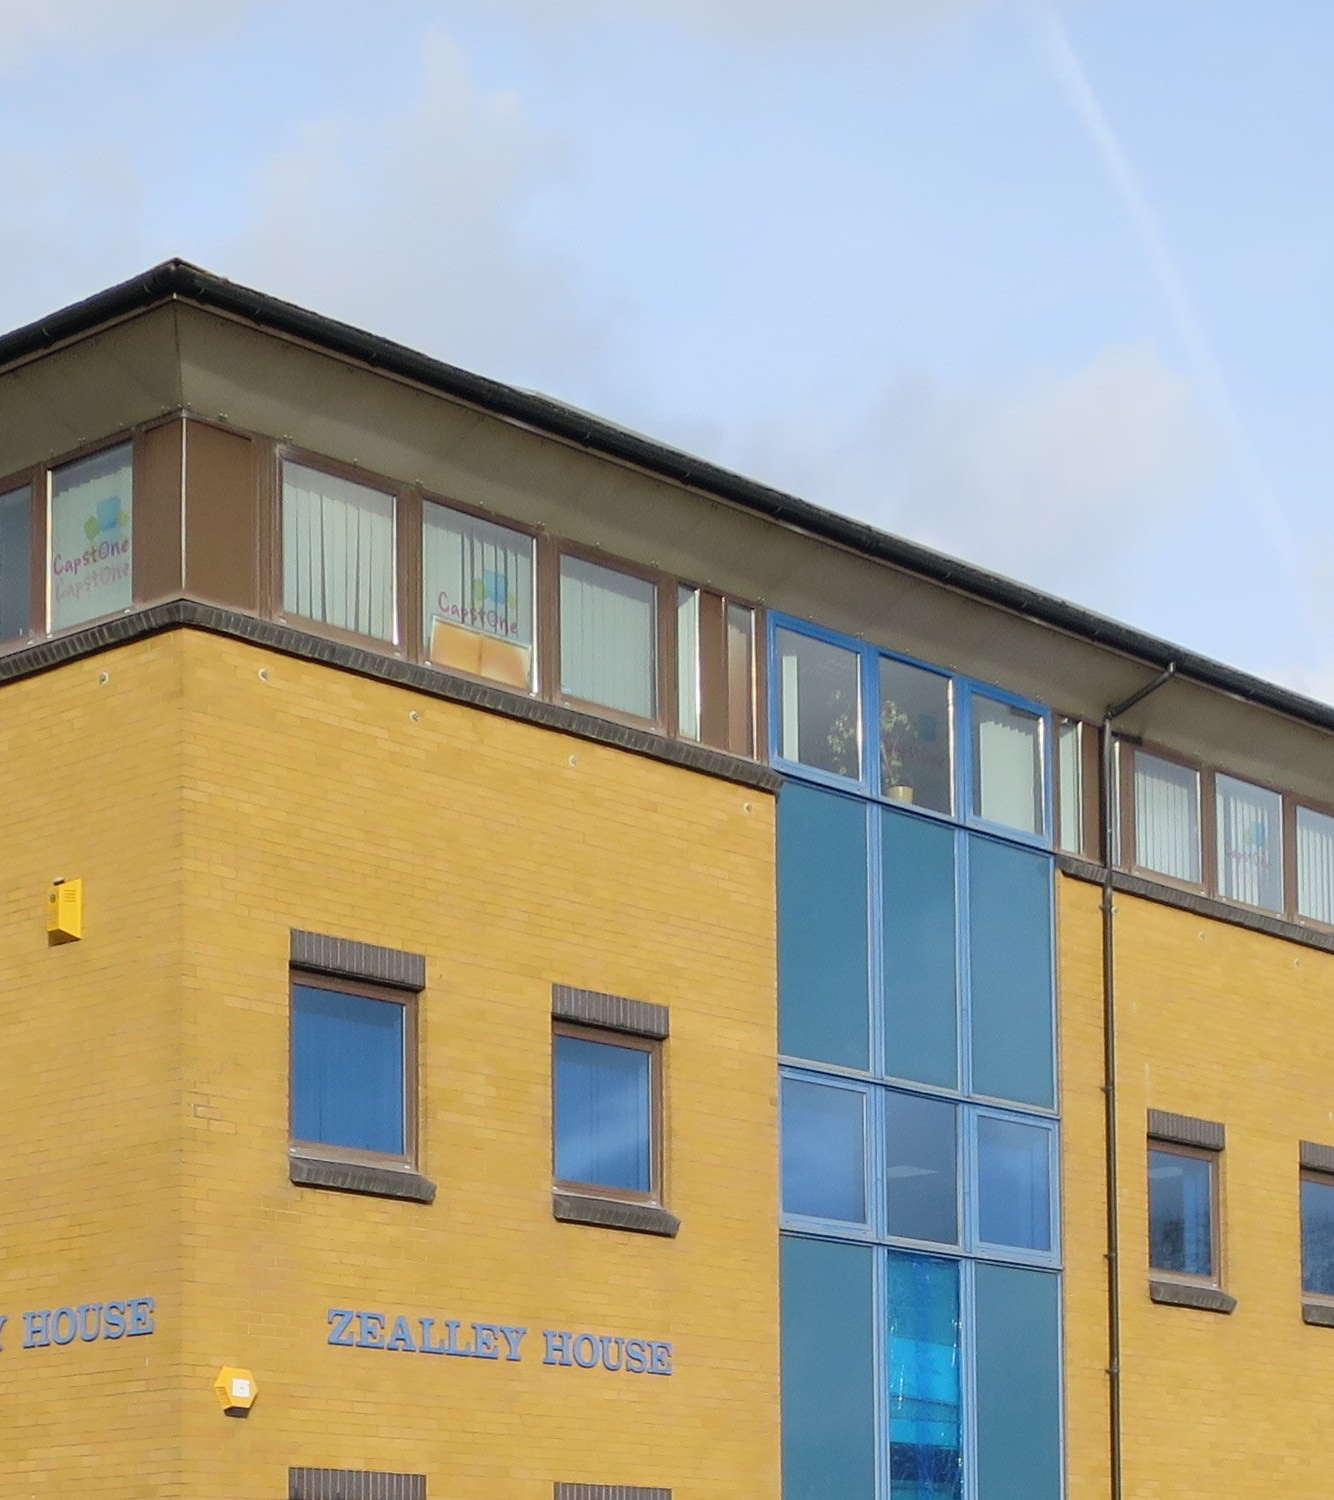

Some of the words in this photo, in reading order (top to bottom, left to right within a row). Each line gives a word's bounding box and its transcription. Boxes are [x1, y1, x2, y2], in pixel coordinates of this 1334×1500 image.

[22, 1297, 155, 1349] HOUSE
[327, 1308, 527, 1361] ZEALLEY
[542, 1329, 673, 1375] HOUSE
